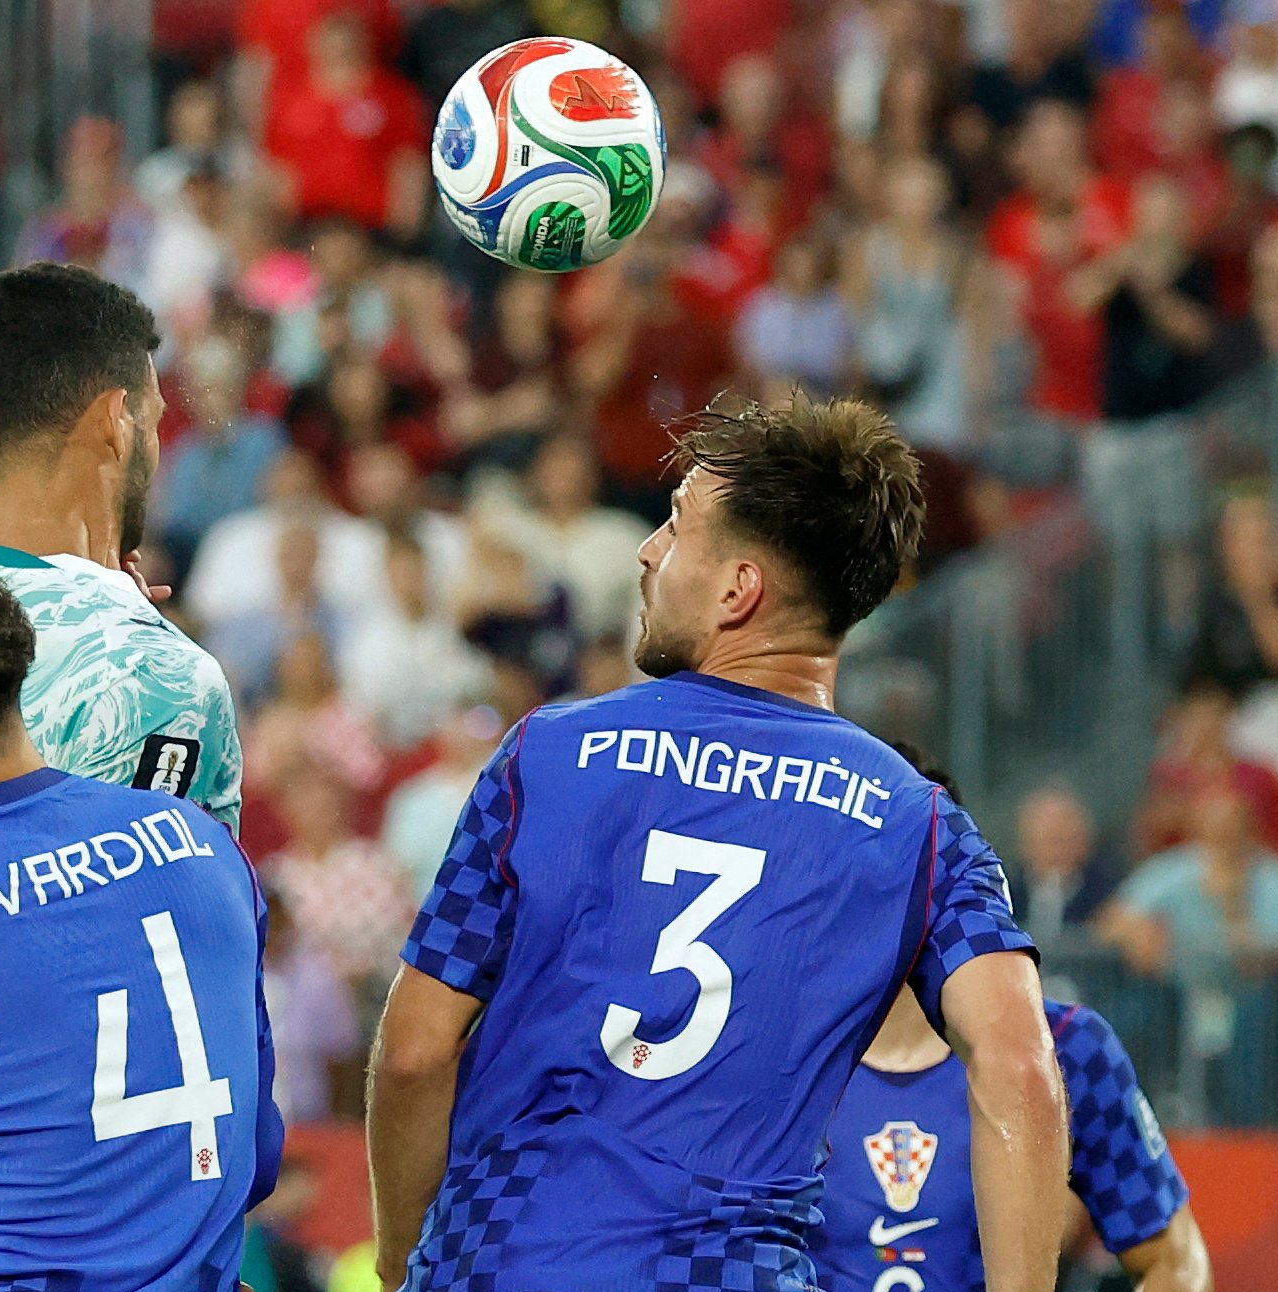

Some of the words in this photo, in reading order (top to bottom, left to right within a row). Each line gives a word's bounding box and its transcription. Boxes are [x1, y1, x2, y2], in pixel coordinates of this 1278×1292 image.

[577, 729, 891, 829] PONGRAČIĆ
[91, 910, 233, 1182] 4
[599, 828, 767, 1081] 3
